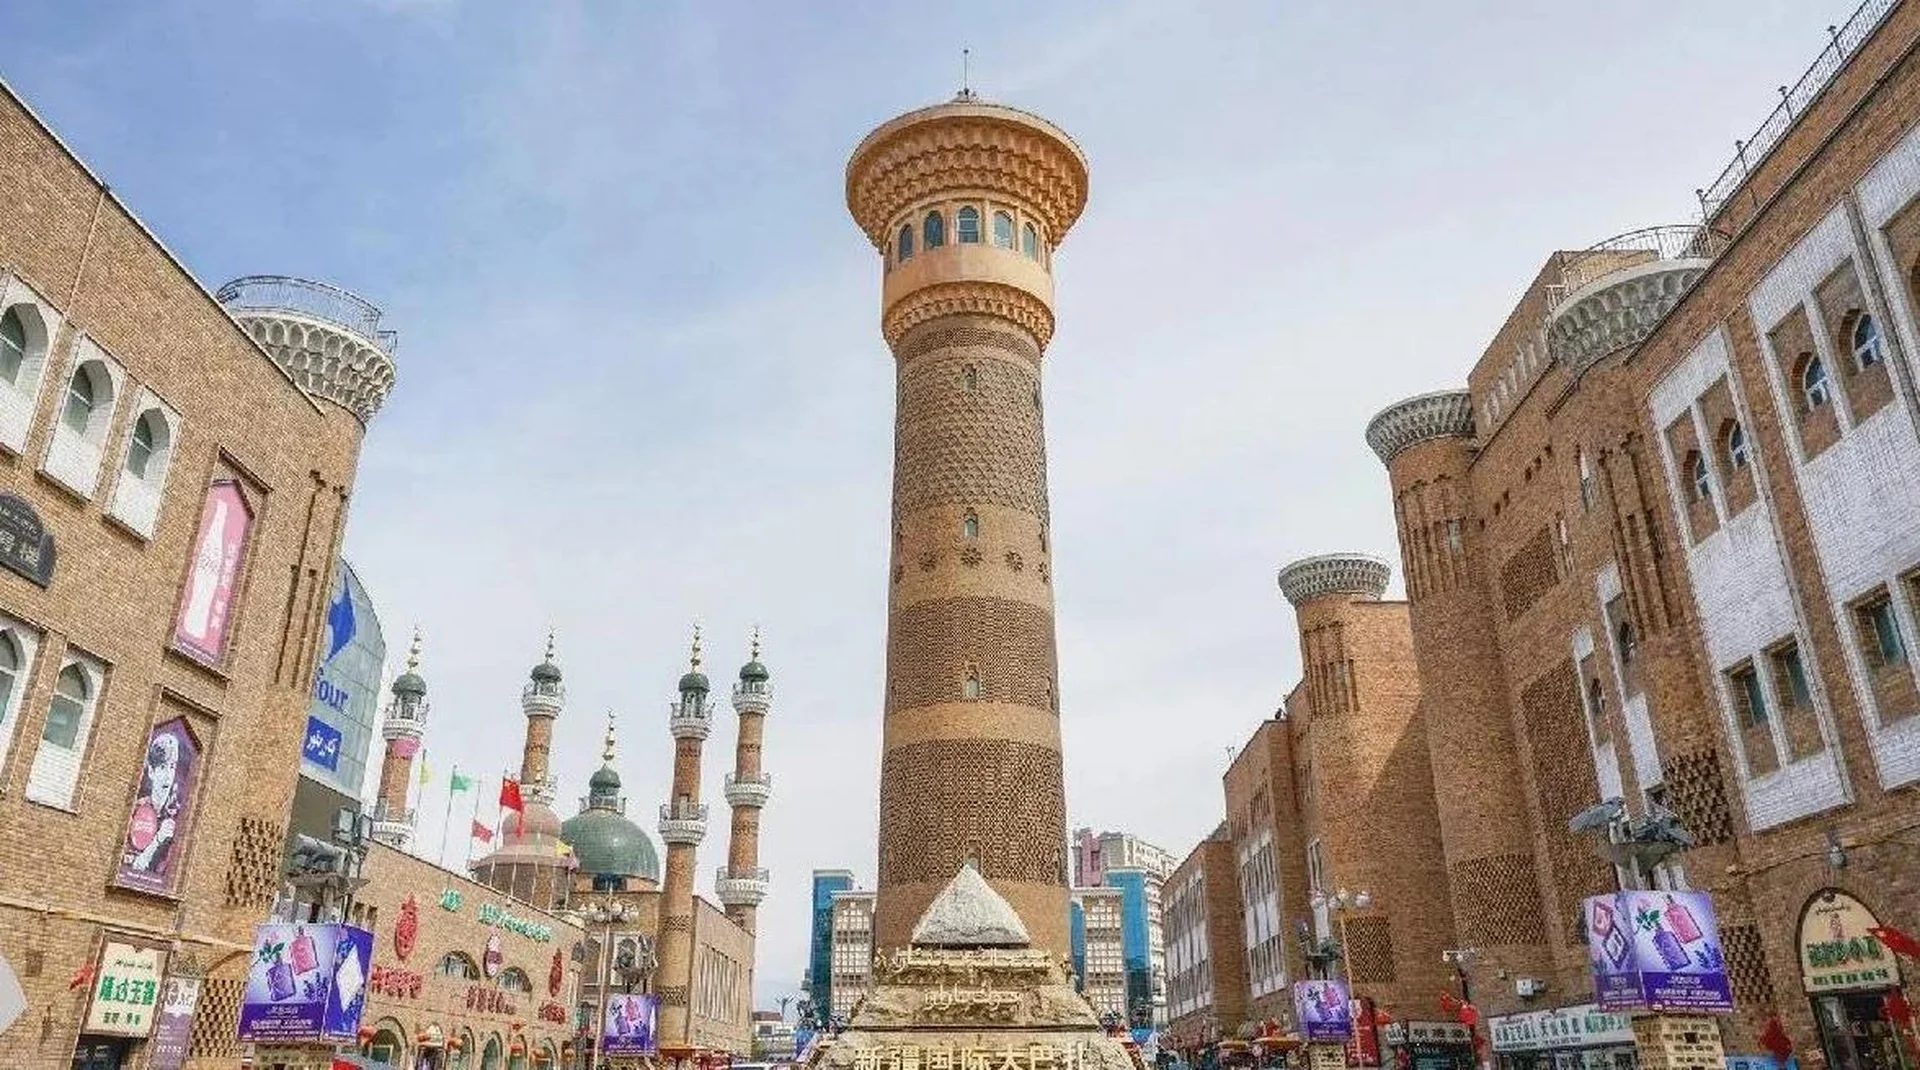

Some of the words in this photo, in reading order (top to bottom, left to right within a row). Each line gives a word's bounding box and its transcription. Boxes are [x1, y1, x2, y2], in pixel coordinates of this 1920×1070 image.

[853, 1043, 1086, 1070] 新疆国际大巴扎
